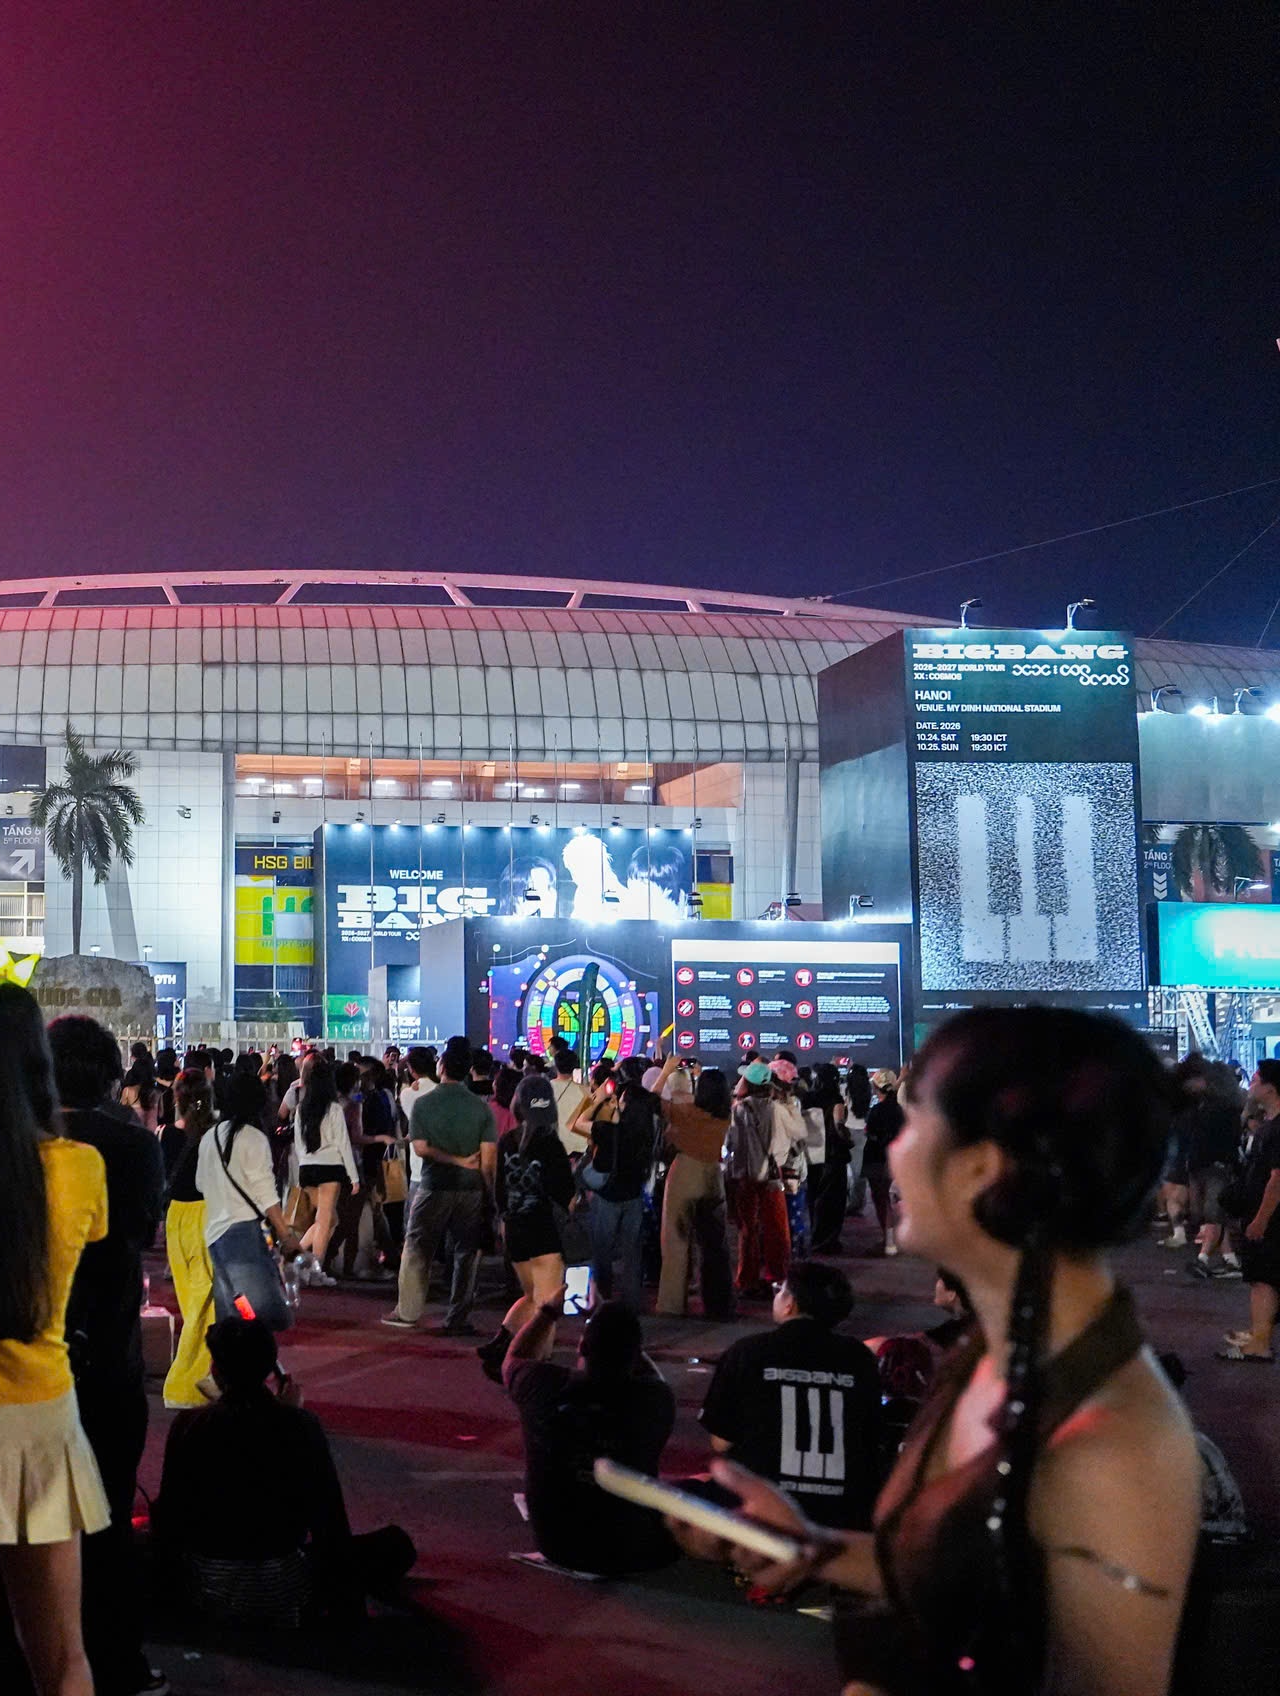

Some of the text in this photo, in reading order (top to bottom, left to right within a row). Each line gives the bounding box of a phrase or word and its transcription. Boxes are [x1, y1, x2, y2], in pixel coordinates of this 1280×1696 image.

[912, 643, 1129, 659] BIGBANG
[958, 664, 984, 672] WORLD
[985, 664, 1005, 672] TOUR
[915, 690, 951, 700] HANOI
[947, 704, 961, 712] MY
[961, 704, 982, 712] DINH
[983, 704, 1023, 712] NATIONAL
[1024, 704, 1061, 713] STADIUM
[940, 722, 961, 730] 2026
[941, 733, 956, 741] SAT
[970, 734, 993, 742] 19:30
[994, 734, 1007, 742] ICT
[941, 743, 959, 751] SUN
[971, 743, 993, 751] 19:30
[994, 743, 1007, 751] ICT
[14, 837, 40, 845] FLOOR
[254, 855, 288, 869] HSG
[1153, 862, 1173, 870] FLOO
[390, 870, 443, 881] WELCOME
[337, 884, 496, 913] BIG
[337, 911, 466, 930] BAN
[154, 974, 177, 985] OTH
